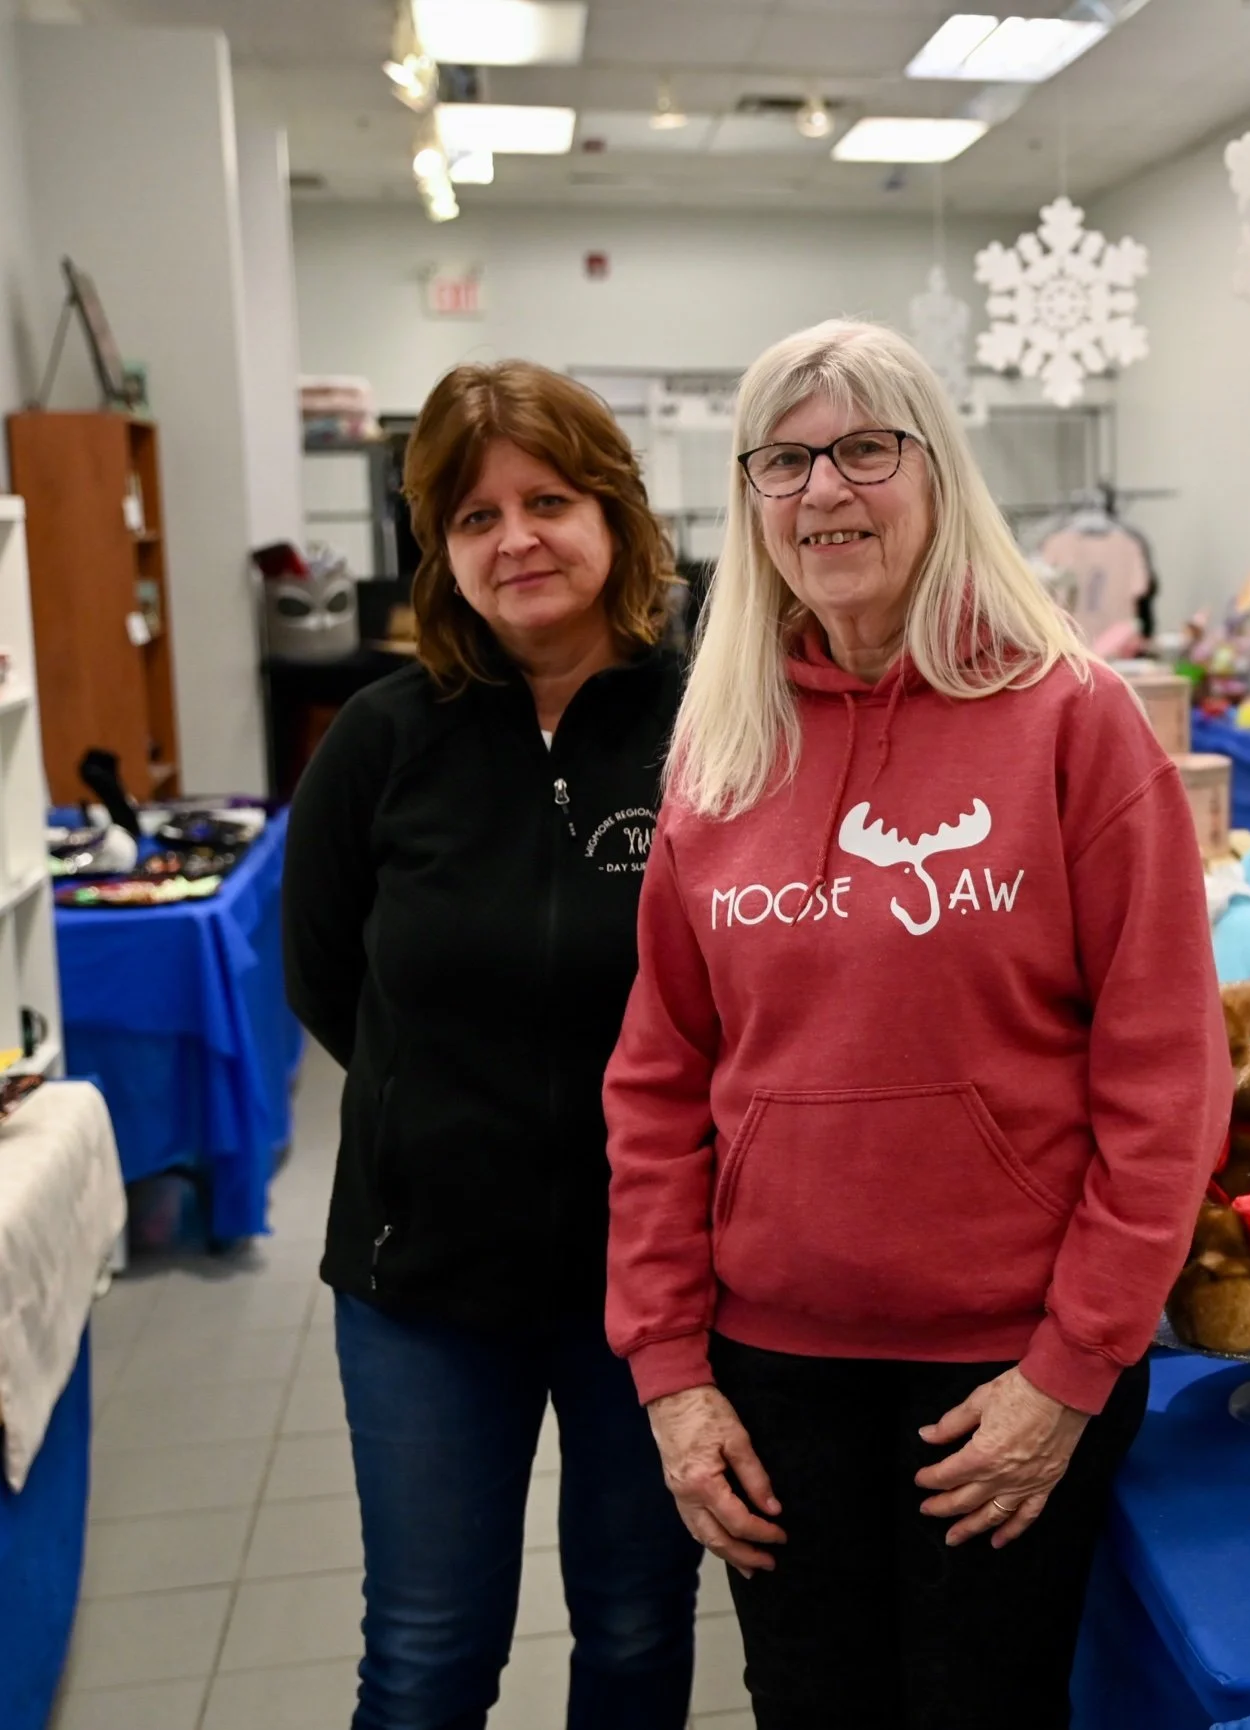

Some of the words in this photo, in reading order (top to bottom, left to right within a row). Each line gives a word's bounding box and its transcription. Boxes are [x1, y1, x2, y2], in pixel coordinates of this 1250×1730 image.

[584, 816, 615, 857] WIGMORE
[606, 863, 628, 872] DAY
[711, 876, 852, 930] MOOSE
